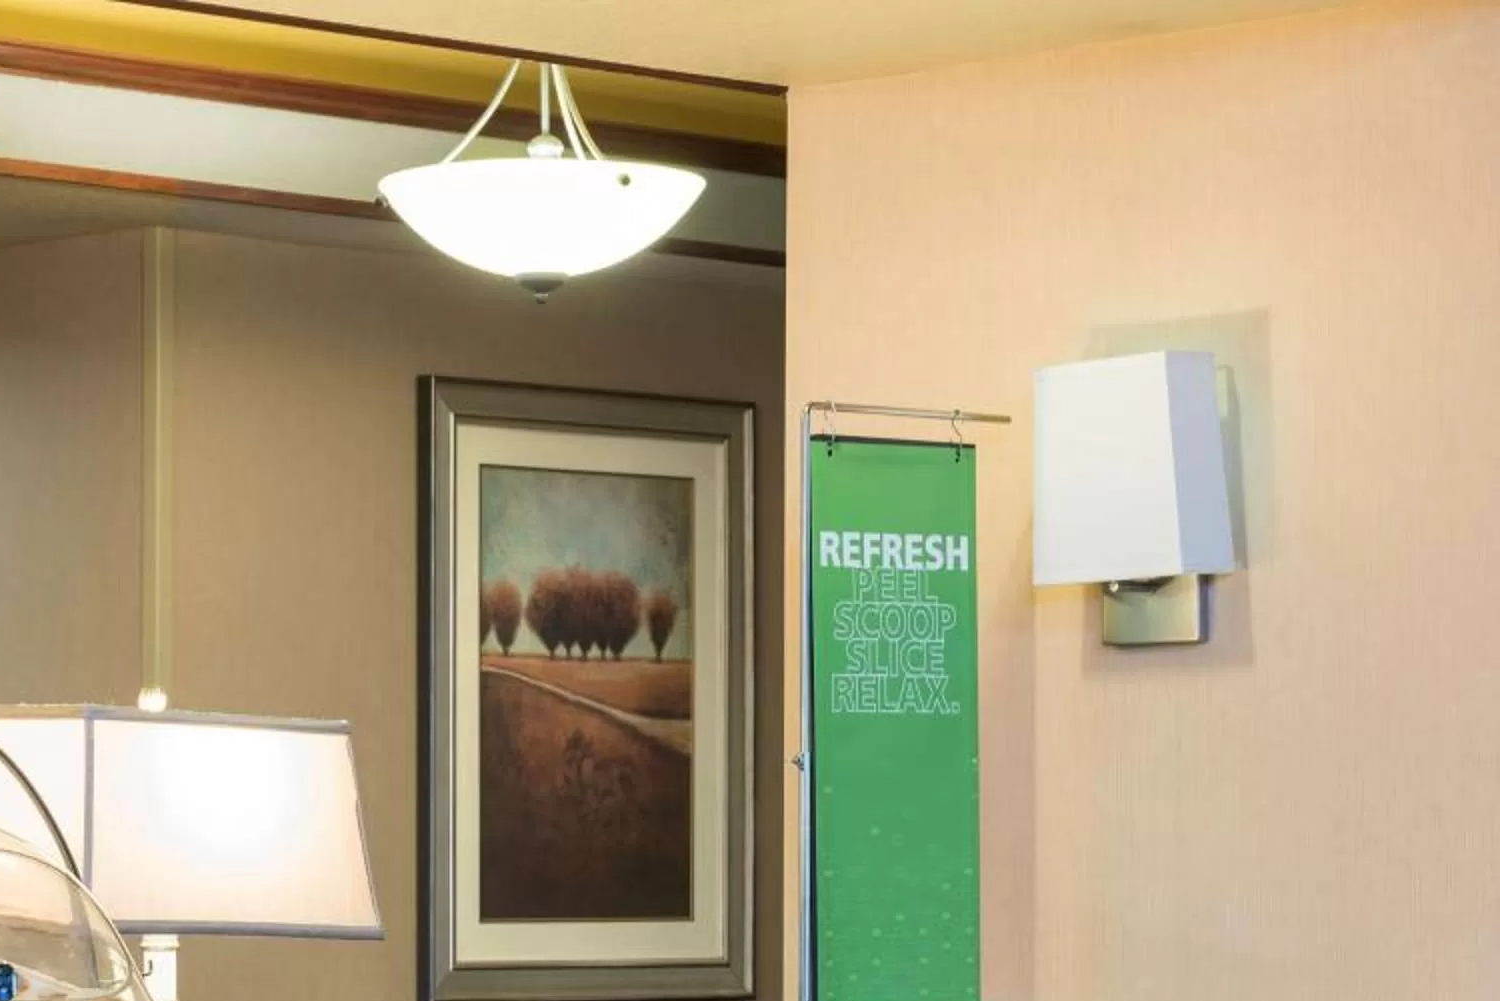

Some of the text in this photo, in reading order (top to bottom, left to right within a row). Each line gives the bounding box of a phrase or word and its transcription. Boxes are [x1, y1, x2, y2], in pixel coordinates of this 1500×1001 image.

[819, 530, 969, 572] REFRESH
[852, 566, 939, 604] PEEL
[833, 601, 957, 642] SCOOP
[846, 637, 945, 677] SLICE
[831, 673, 961, 714] RELAX.
